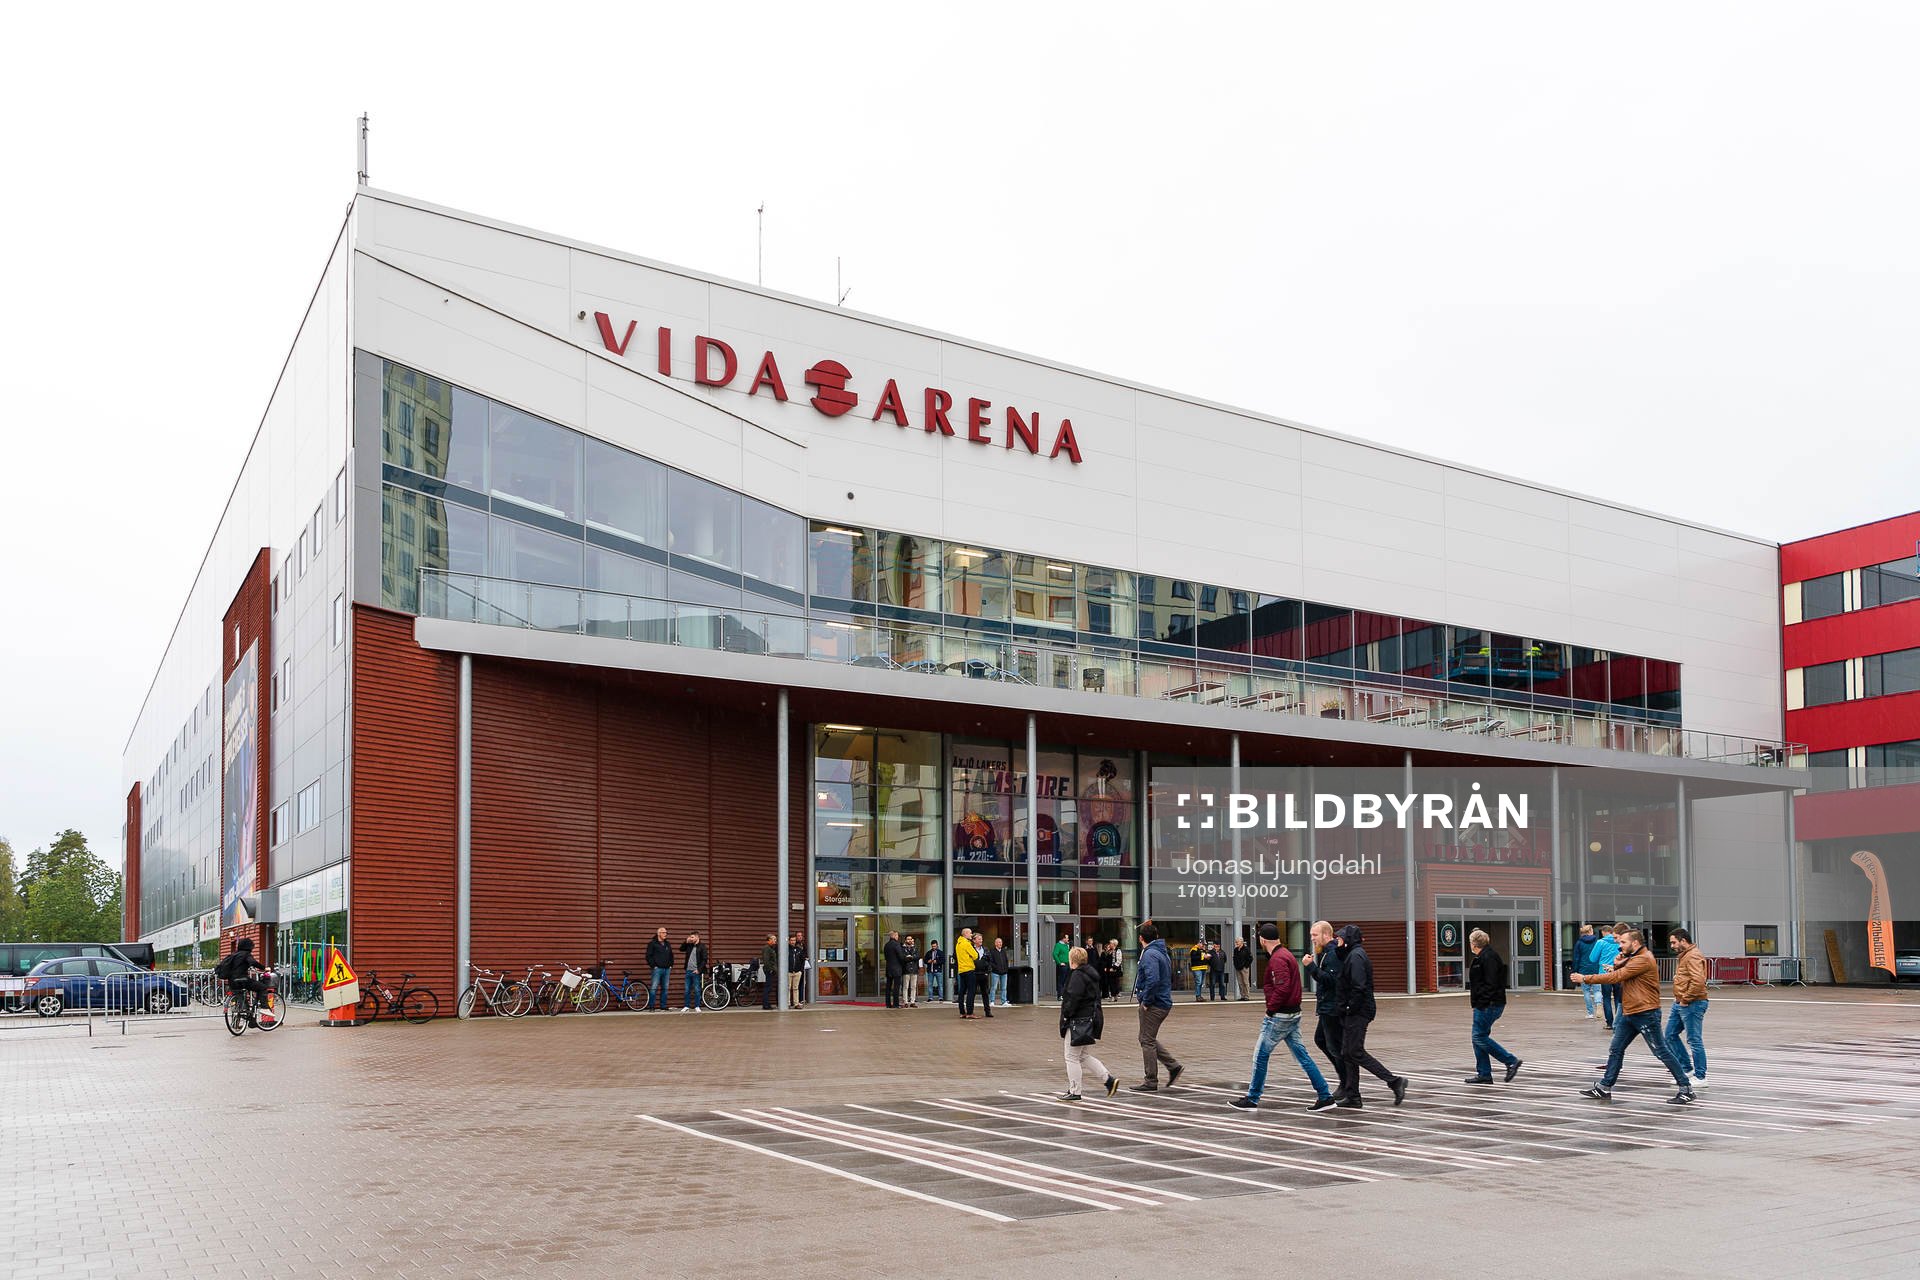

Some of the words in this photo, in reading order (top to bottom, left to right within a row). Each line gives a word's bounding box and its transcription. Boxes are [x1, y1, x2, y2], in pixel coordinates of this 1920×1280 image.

[594, 311, 789, 402] VIDA
[872, 378, 1083, 464] ARENA
[951, 756, 974, 769] ÄXJÖ
